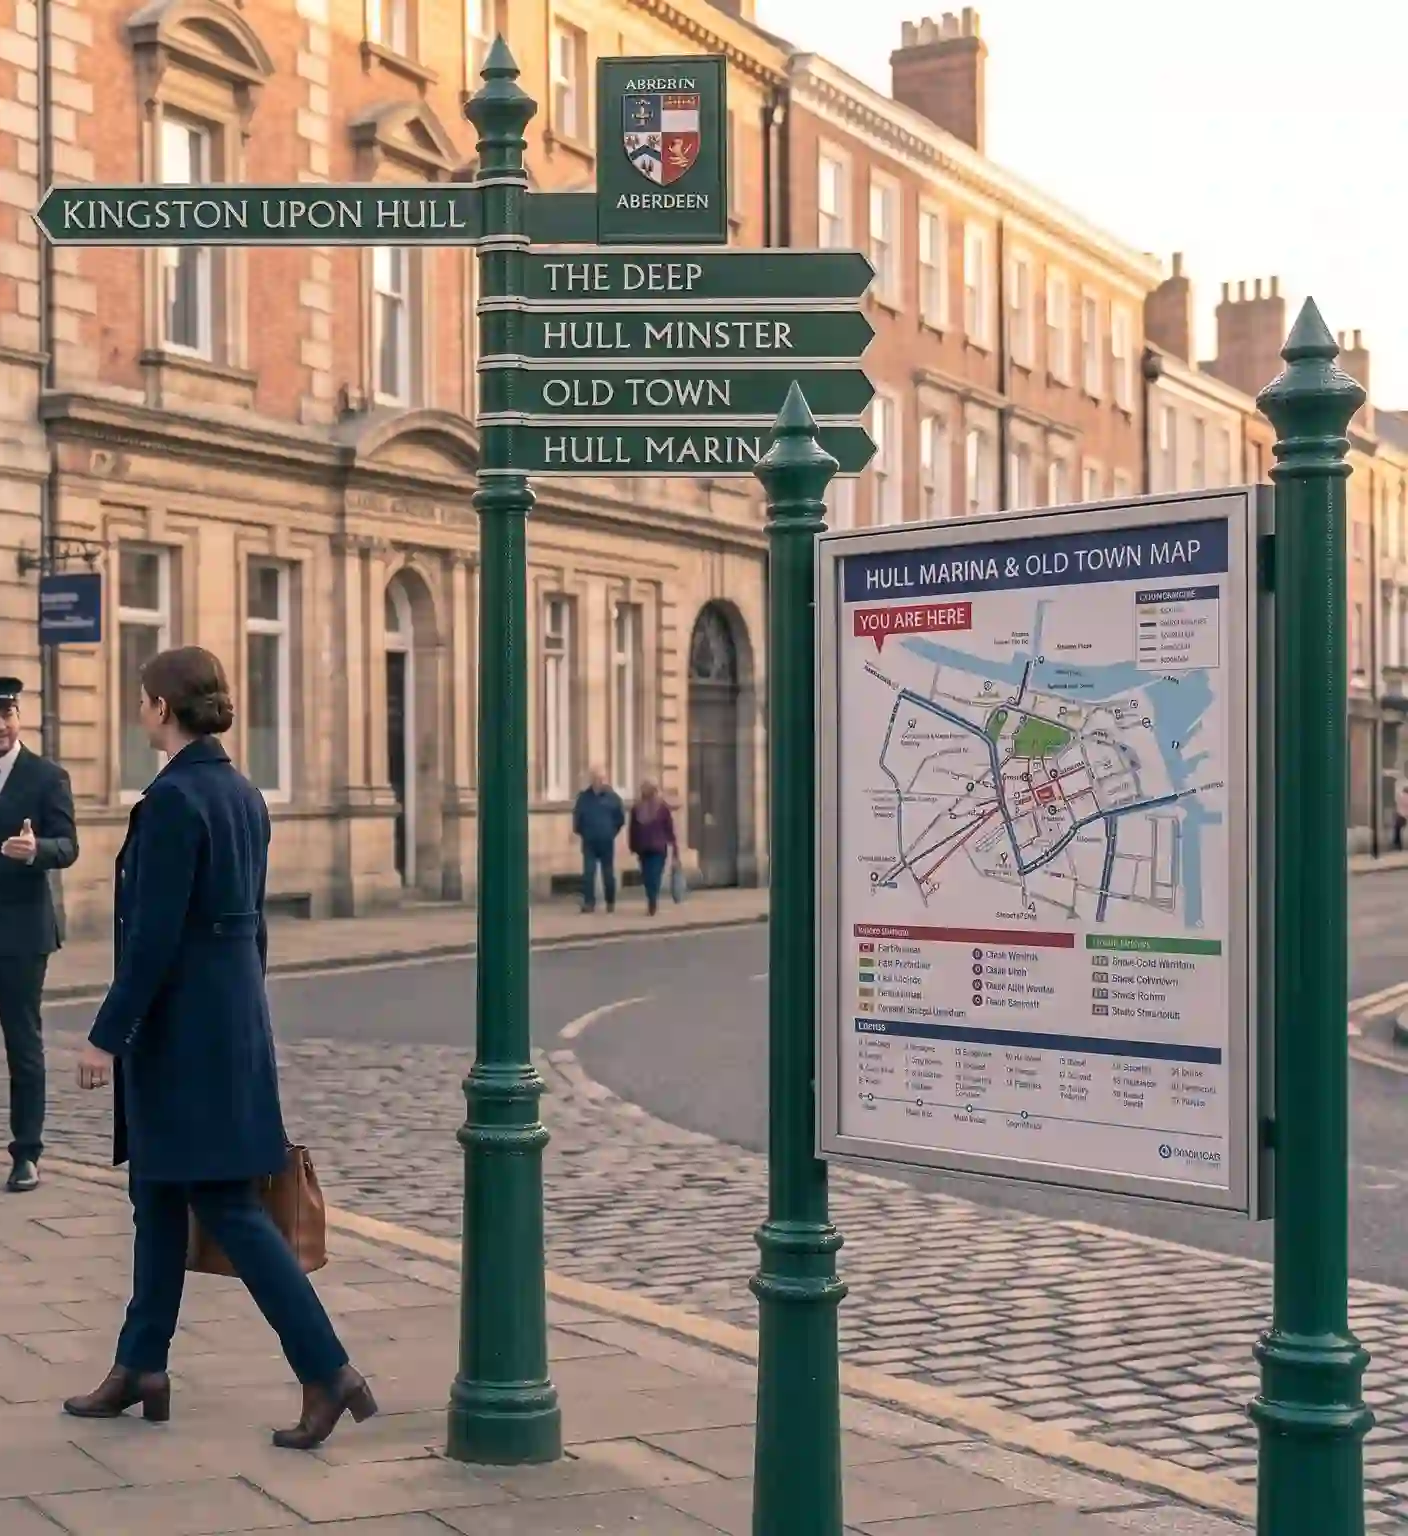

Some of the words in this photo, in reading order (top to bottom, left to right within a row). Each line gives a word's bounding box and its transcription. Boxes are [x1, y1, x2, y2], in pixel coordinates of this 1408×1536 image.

[63, 200, 248, 229] KINGSTON
[262, 200, 362, 229] UPON
[376, 200, 466, 229] HULL
[616, 194, 709, 209] ABERDEEN
[543, 263, 611, 291] THE
[623, 263, 703, 291] DEEP
[543, 322, 631, 349] HULL
[644, 322, 794, 349] MINSTER
[542, 379, 614, 407] OLD
[625, 379, 731, 406] TOWN
[544, 436, 631, 463] HULL
[645, 436, 780, 463] MARIN
[866, 566, 915, 590] HULL
[919, 558, 999, 586] MARINA
[1004, 556, 1020, 578] &
[1025, 552, 1069, 577] OLD
[1074, 544, 1142, 572] TOWN
[1150, 539, 1201, 566] MAP
[860, 614, 890, 630] YOU
[894, 609, 925, 629] ARE
[927, 607, 966, 626] HERE
